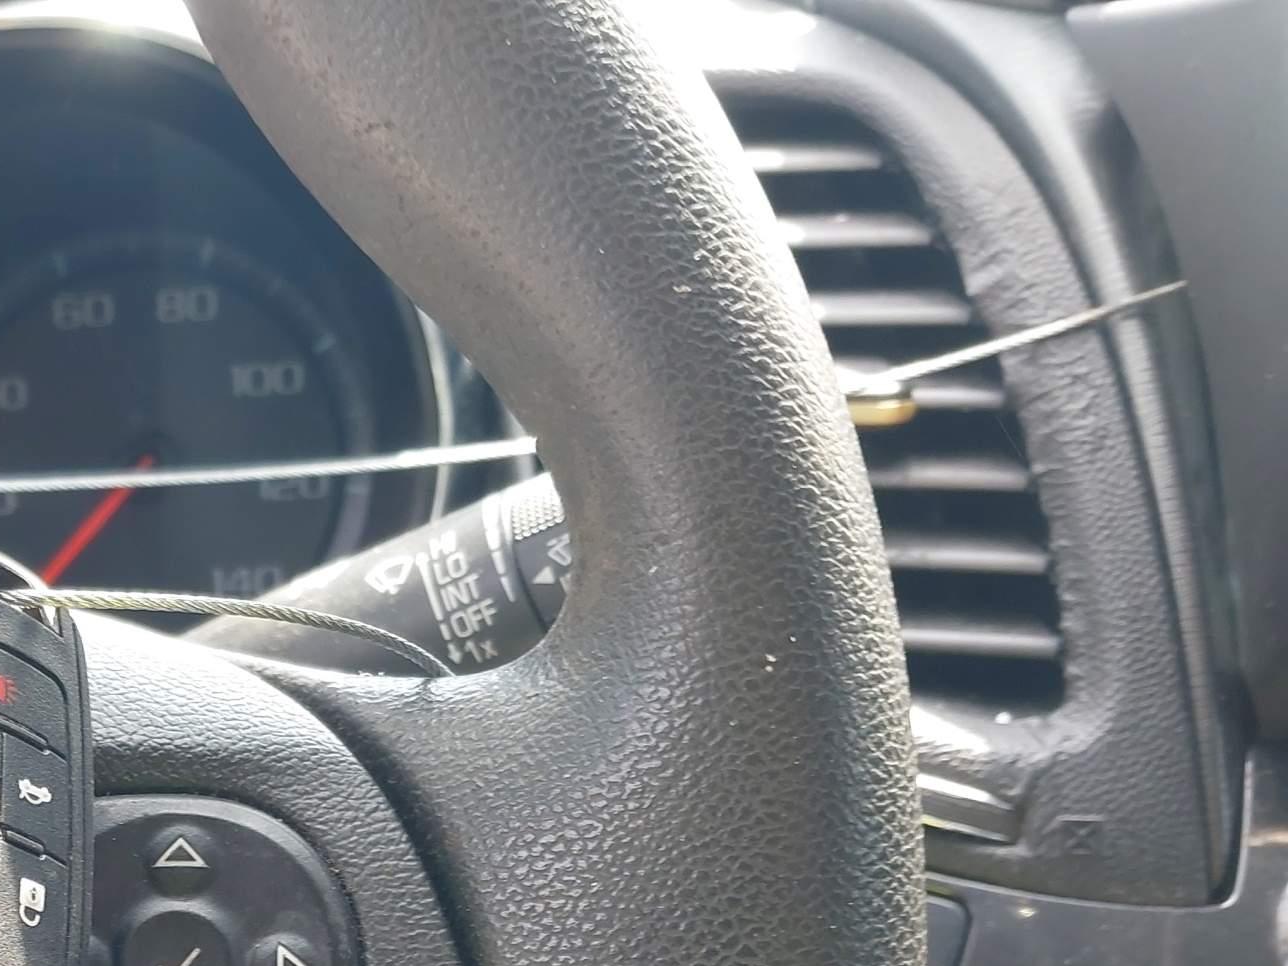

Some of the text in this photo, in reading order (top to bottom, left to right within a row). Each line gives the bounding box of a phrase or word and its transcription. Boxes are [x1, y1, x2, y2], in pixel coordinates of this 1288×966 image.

[52, 293, 114, 330] 60
[155, 288, 218, 323] 80
[230, 362, 305, 398] 100
[433, 552, 469, 586] LO
[439, 573, 481, 613] INT
[449, 598, 498, 639] OFF
